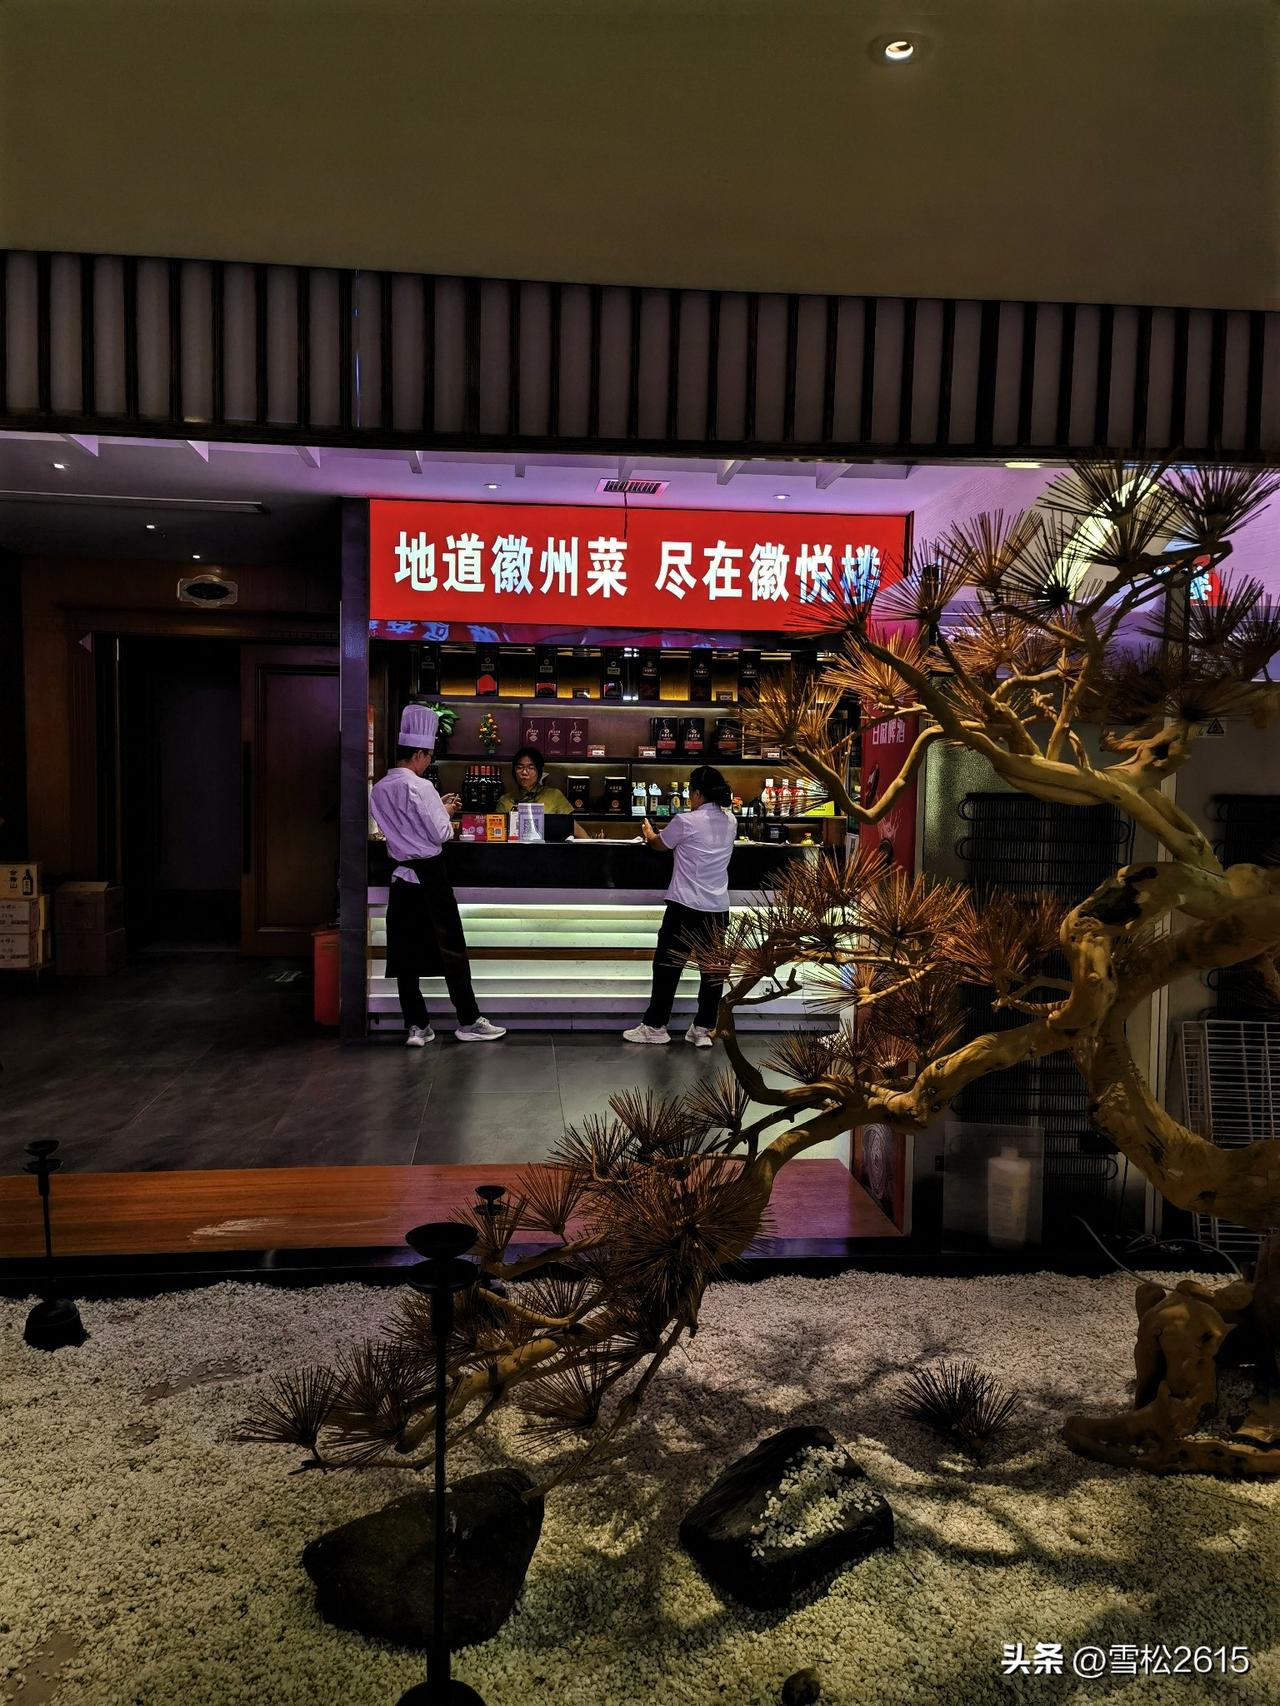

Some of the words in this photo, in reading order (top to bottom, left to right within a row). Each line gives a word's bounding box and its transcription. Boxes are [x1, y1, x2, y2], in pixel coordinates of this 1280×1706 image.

[394, 531, 628, 598] 地道徽州菜
[654, 540, 881, 604] 尽在徽悦楼
